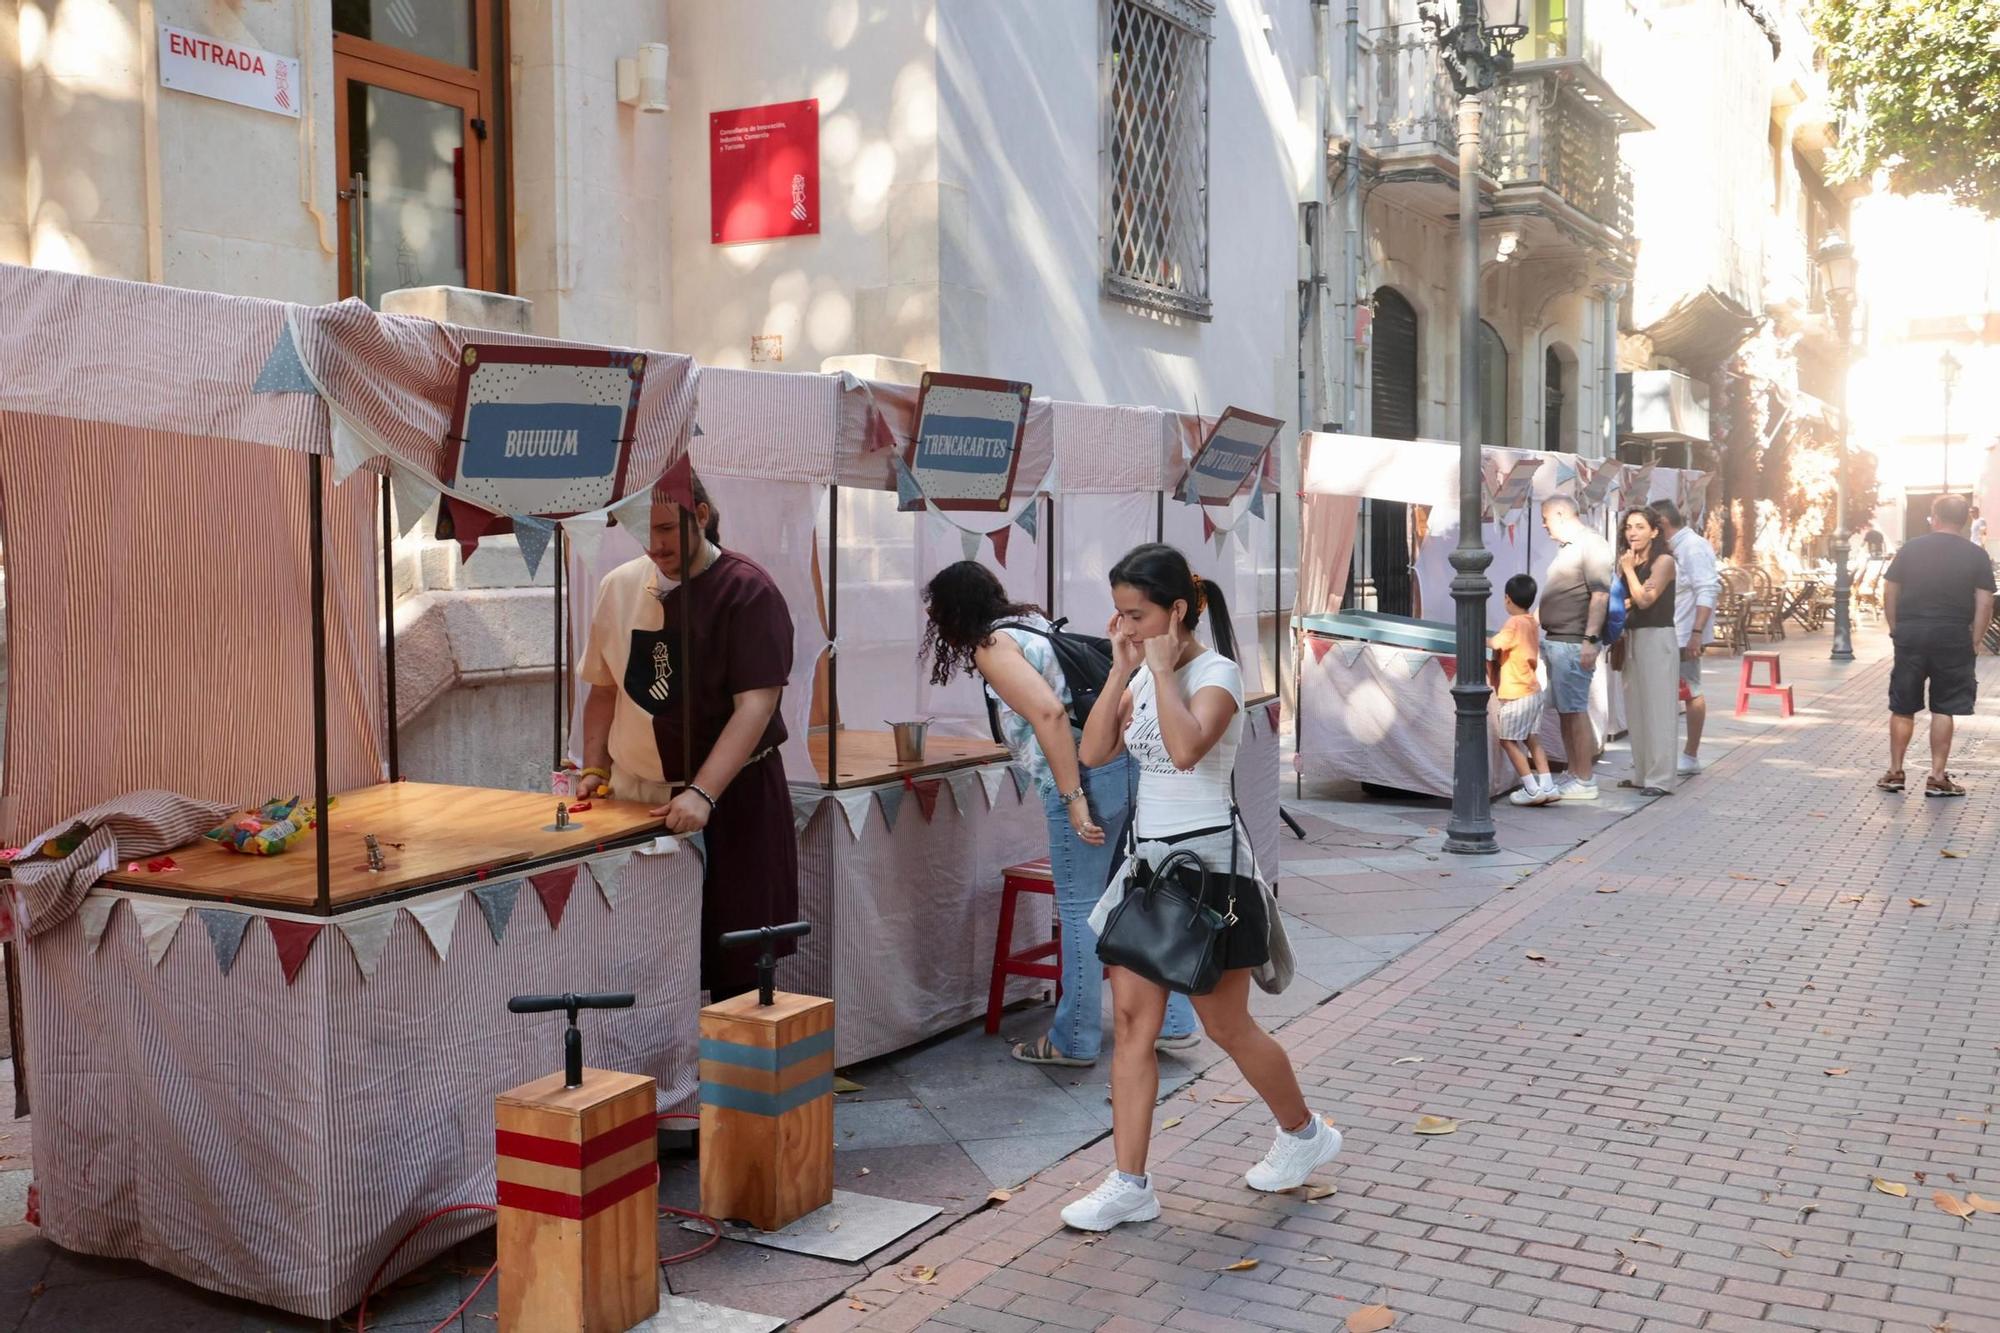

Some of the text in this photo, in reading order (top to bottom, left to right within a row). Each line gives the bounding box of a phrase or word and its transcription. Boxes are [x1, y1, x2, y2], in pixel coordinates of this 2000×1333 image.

[170, 33, 266, 76] ENTRADA
[504, 429, 579, 457] BUUUUM
[924, 434, 1008, 458] TRENCACARTES
